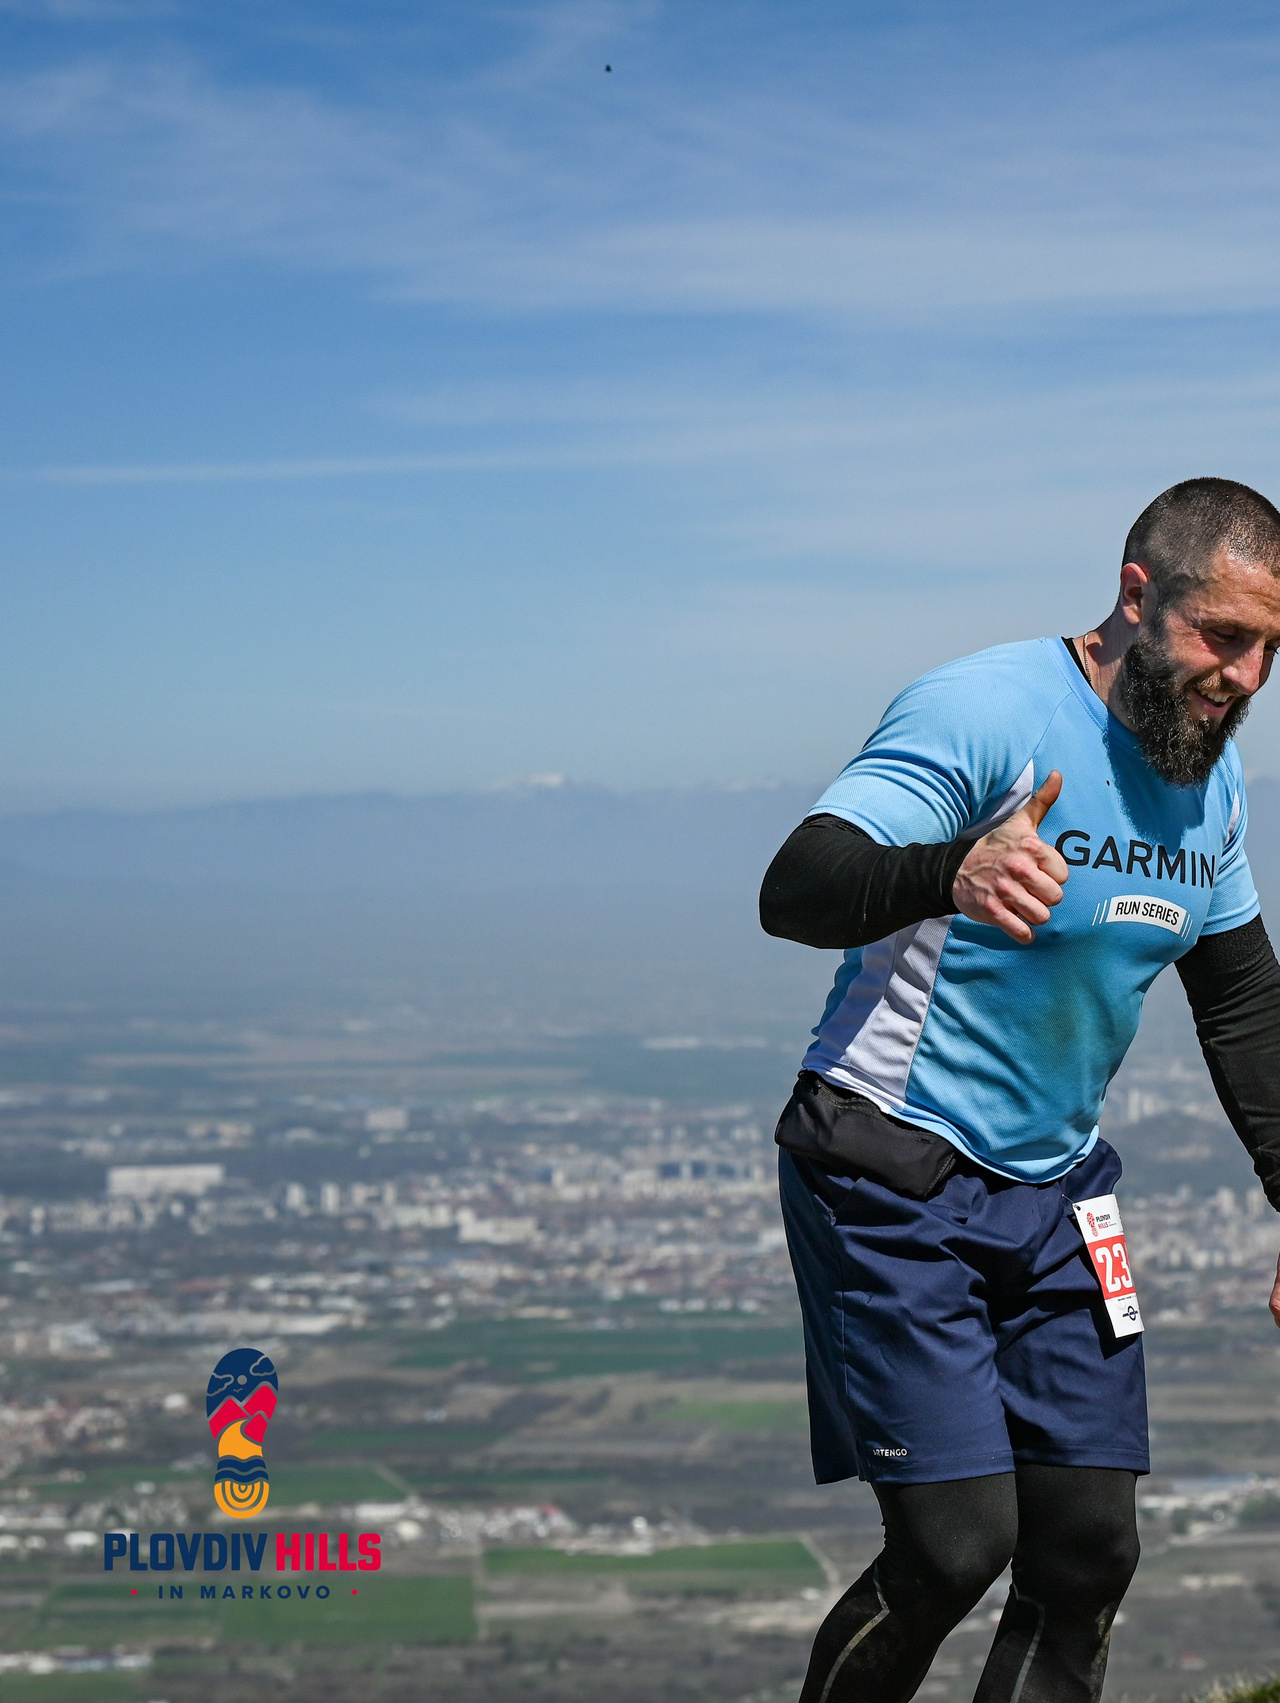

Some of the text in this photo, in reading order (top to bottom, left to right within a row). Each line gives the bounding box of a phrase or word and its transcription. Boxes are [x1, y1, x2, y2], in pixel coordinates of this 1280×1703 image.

[1055, 829, 1216, 889] GARMIN
[1115, 901, 1180, 926] RUN SERIES
